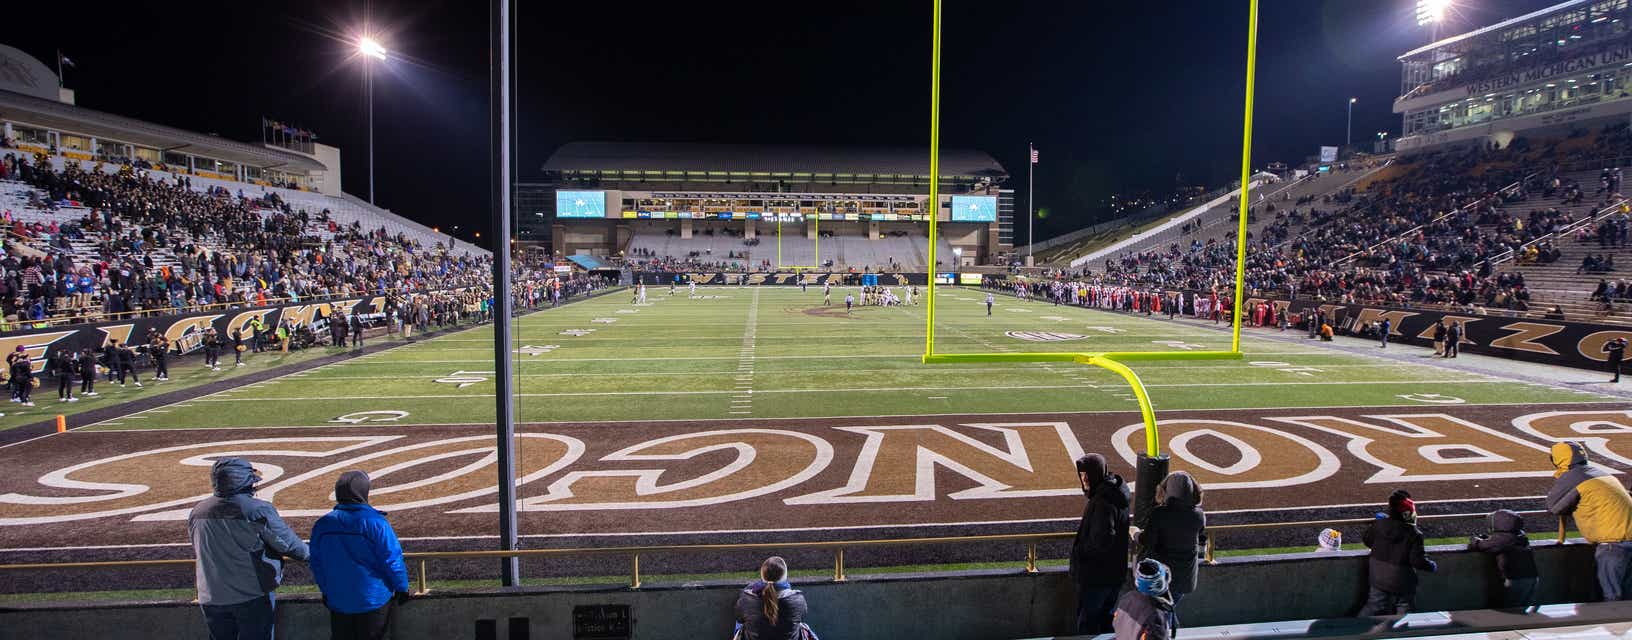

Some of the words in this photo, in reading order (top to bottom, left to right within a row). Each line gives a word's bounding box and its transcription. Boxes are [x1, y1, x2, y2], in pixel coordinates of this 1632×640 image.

[1466, 76, 1521, 95] WESTERN
[1524, 57, 1597, 82] MICHIGAN
[1602, 49, 1632, 65] UNI
